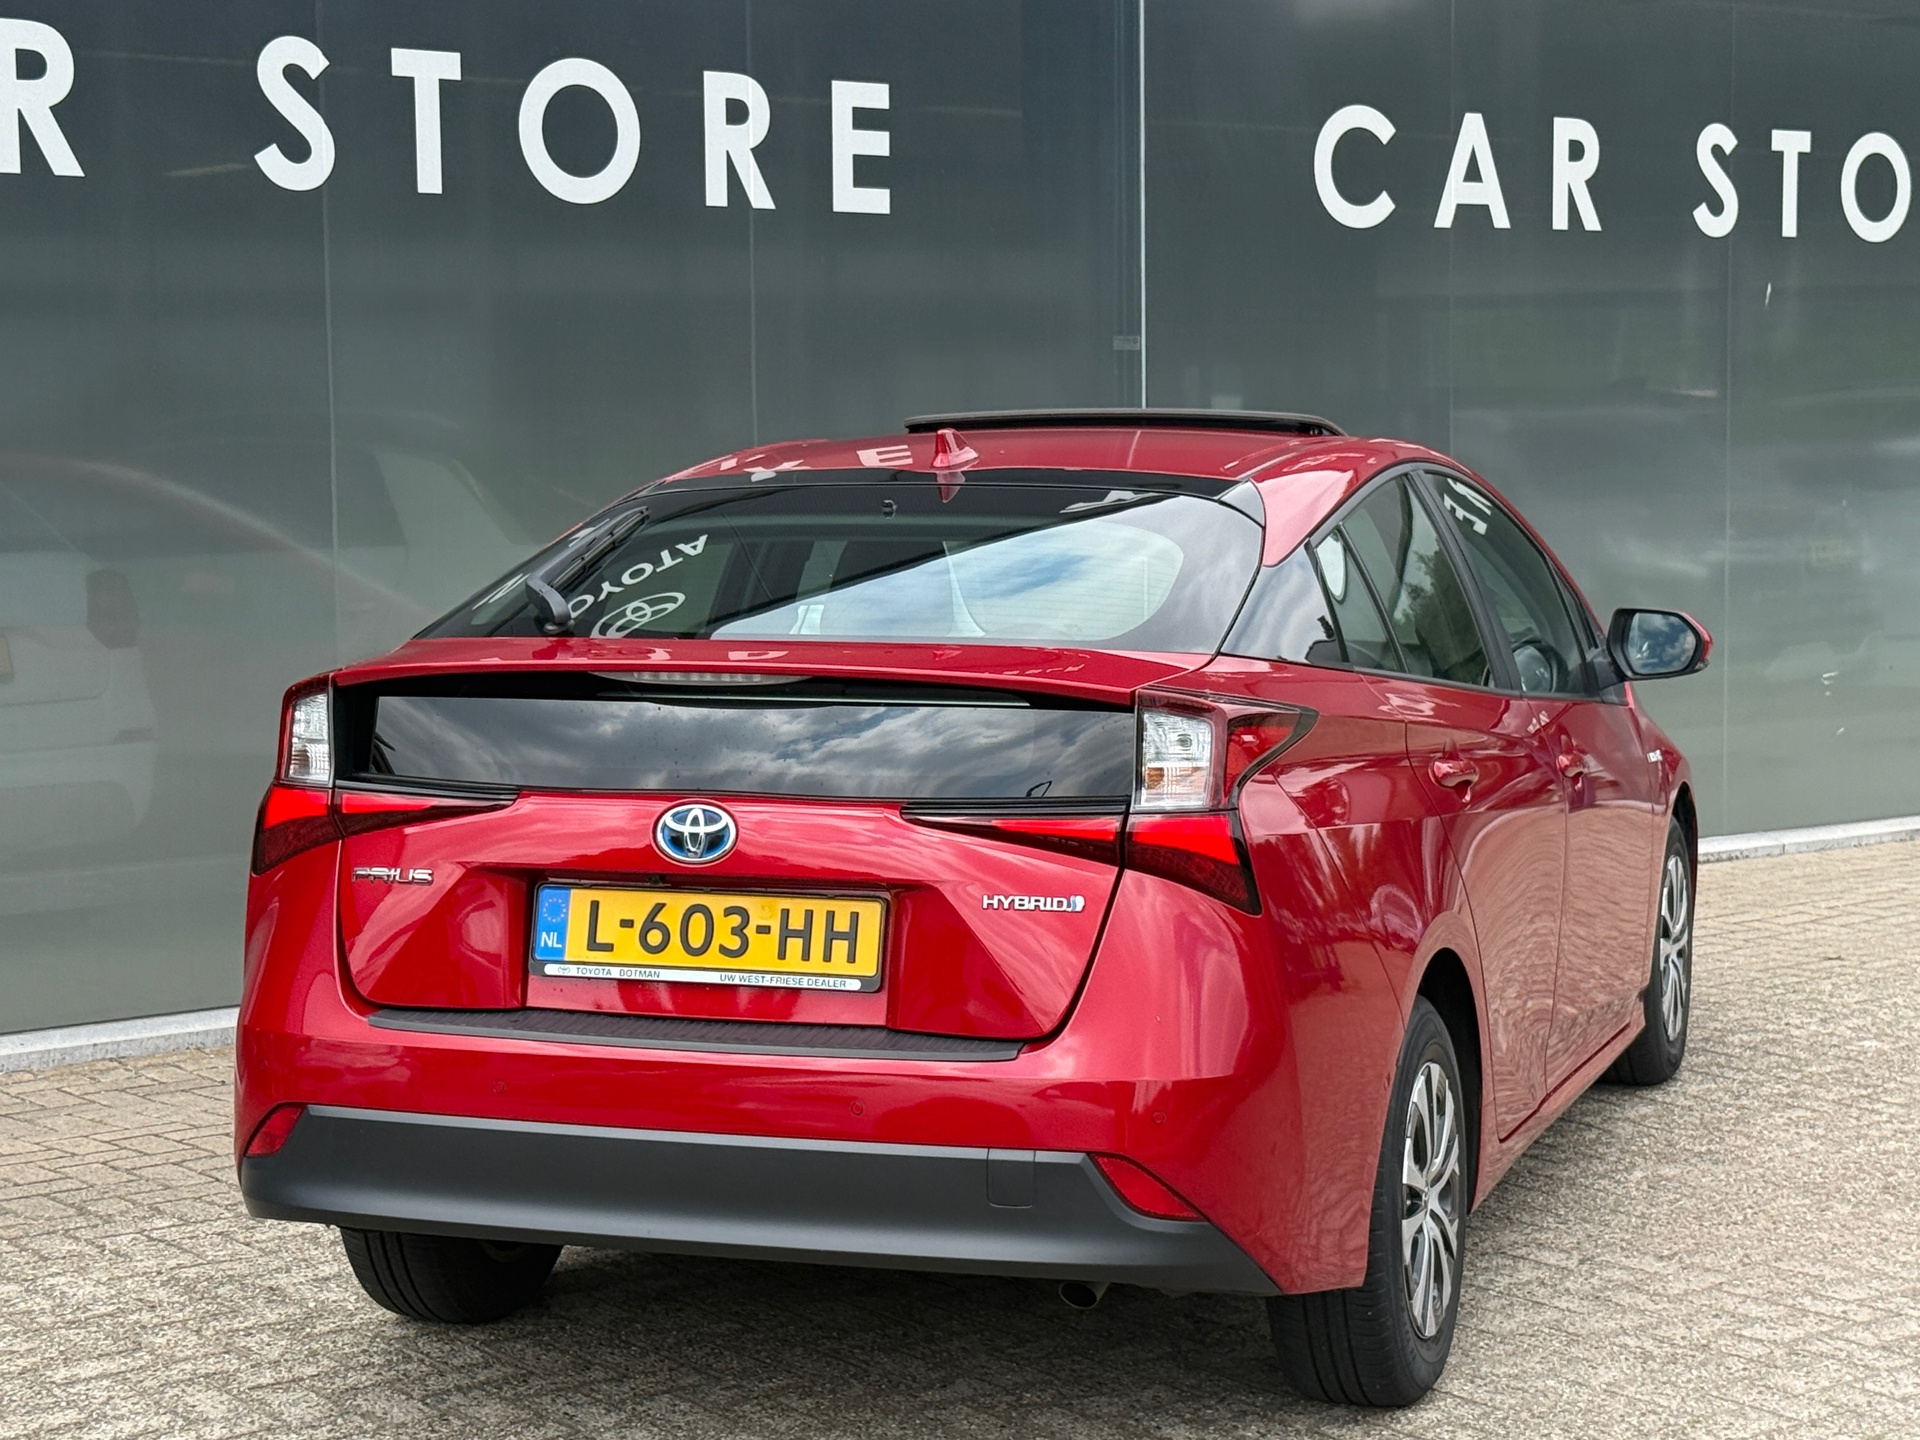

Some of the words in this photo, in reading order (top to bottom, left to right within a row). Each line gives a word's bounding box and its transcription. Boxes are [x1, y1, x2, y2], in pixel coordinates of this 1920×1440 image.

[254, 35, 891, 215] STORE
[1313, 104, 1602, 229] CAR
[1692, 122, 1911, 243] STO
[352, 867, 434, 885] PRIUS
[982, 894, 1067, 912] HYBRID
[540, 931, 562, 948] NL
[586, 900, 860, 964] L-603-HH
[575, 966, 613, 977] TOYOTA
[719, 974, 737, 983] UW
[738, 974, 805, 986] WEST-FRIESE
[806, 978, 847, 989] DEALER
